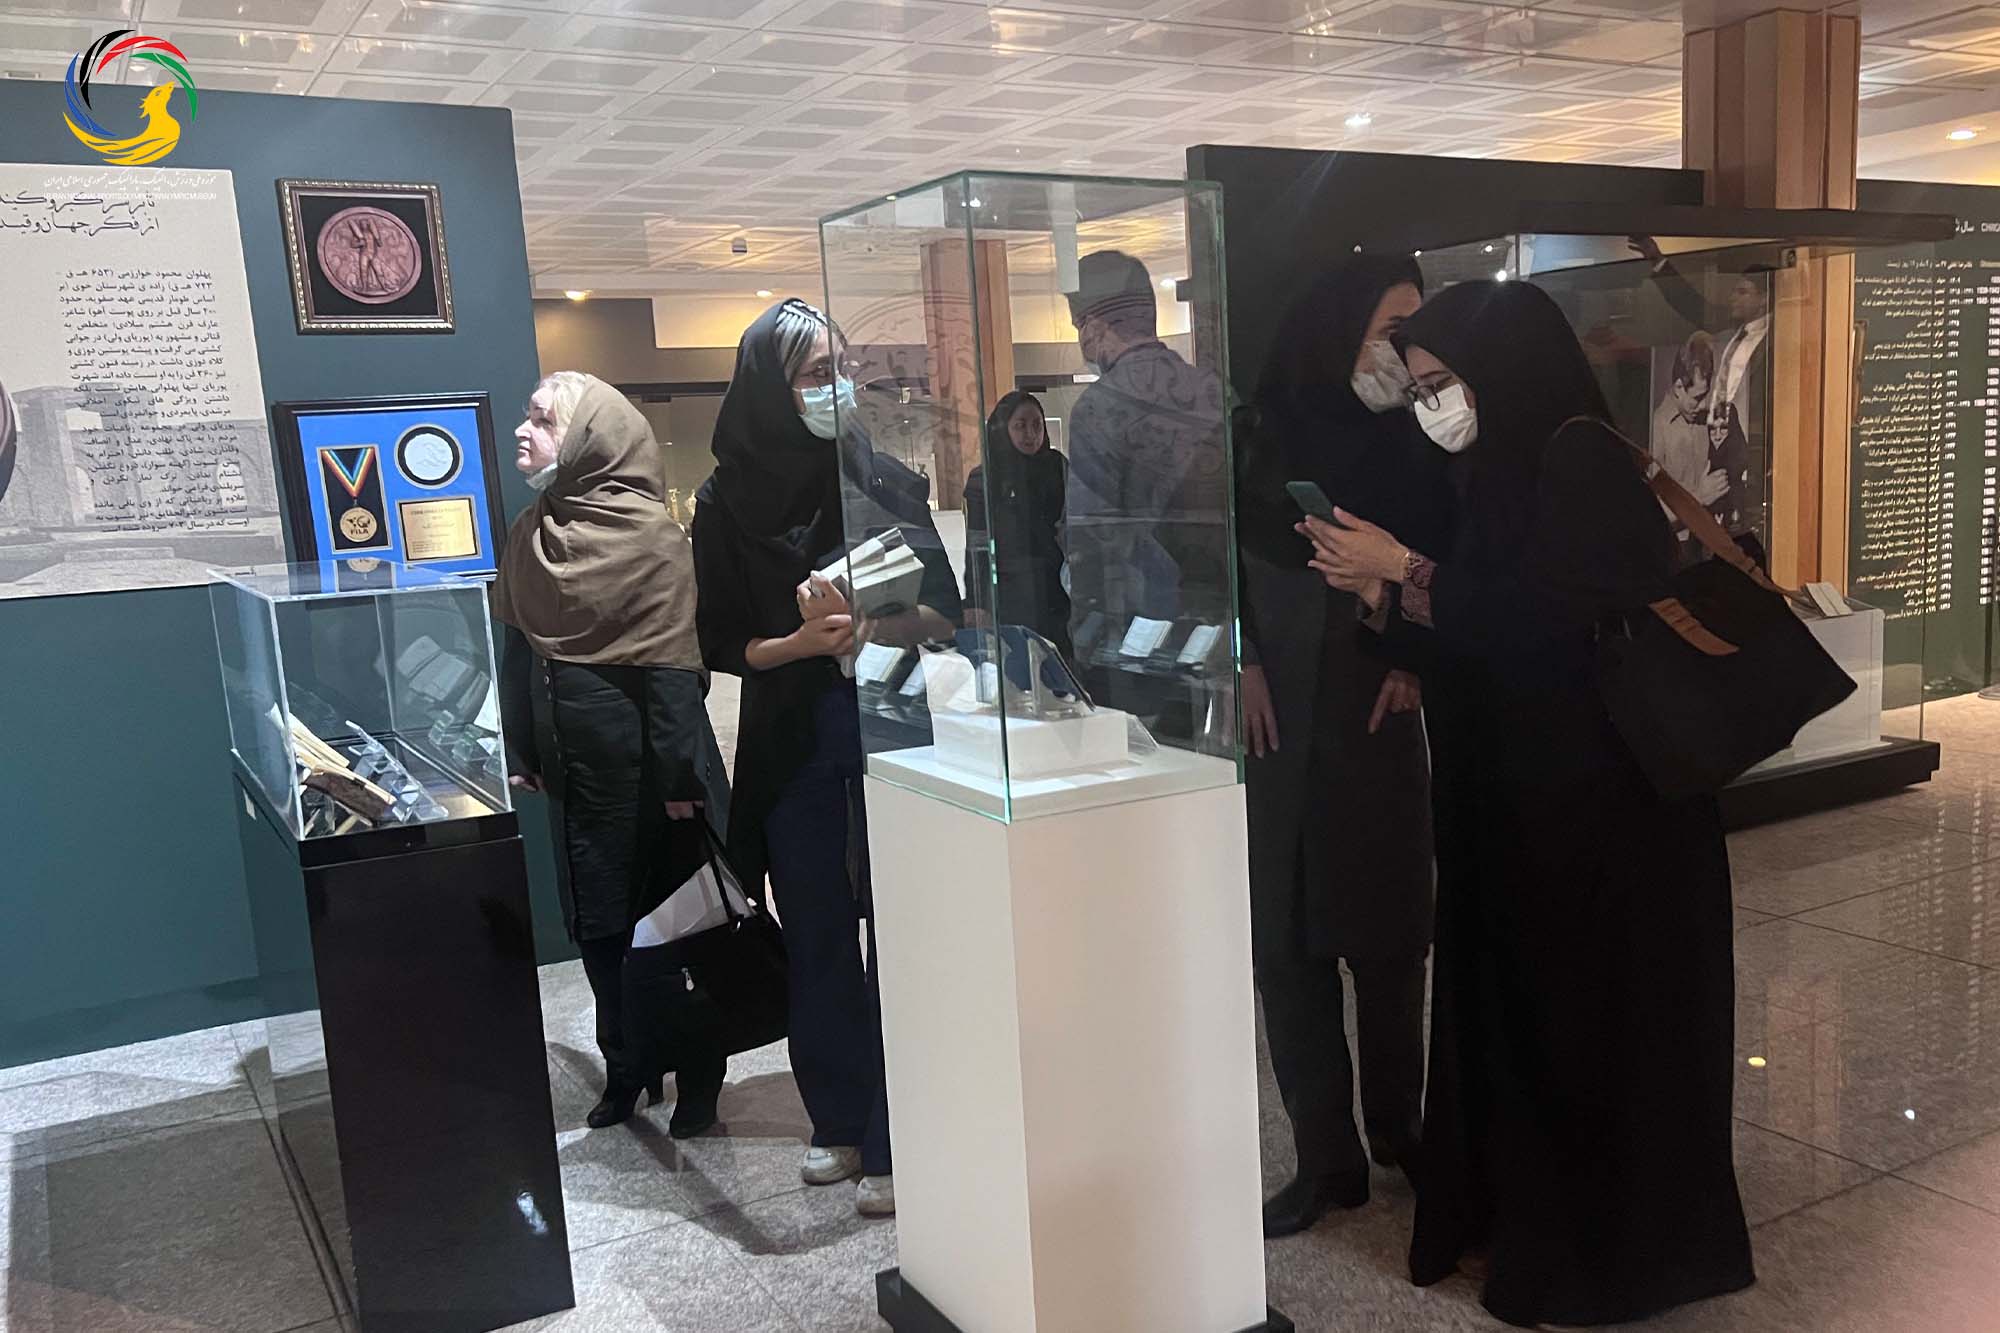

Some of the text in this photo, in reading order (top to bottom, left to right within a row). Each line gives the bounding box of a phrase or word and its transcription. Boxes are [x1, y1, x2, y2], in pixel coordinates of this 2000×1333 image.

[102, 200, 129, 214] سر
[40, 211, 90, 234] جهان
[88, 215, 139, 236] فکر
[140, 216, 160, 236] از
[155, 270, 182, 280] محمود
[185, 269, 212, 280] پهلوان
